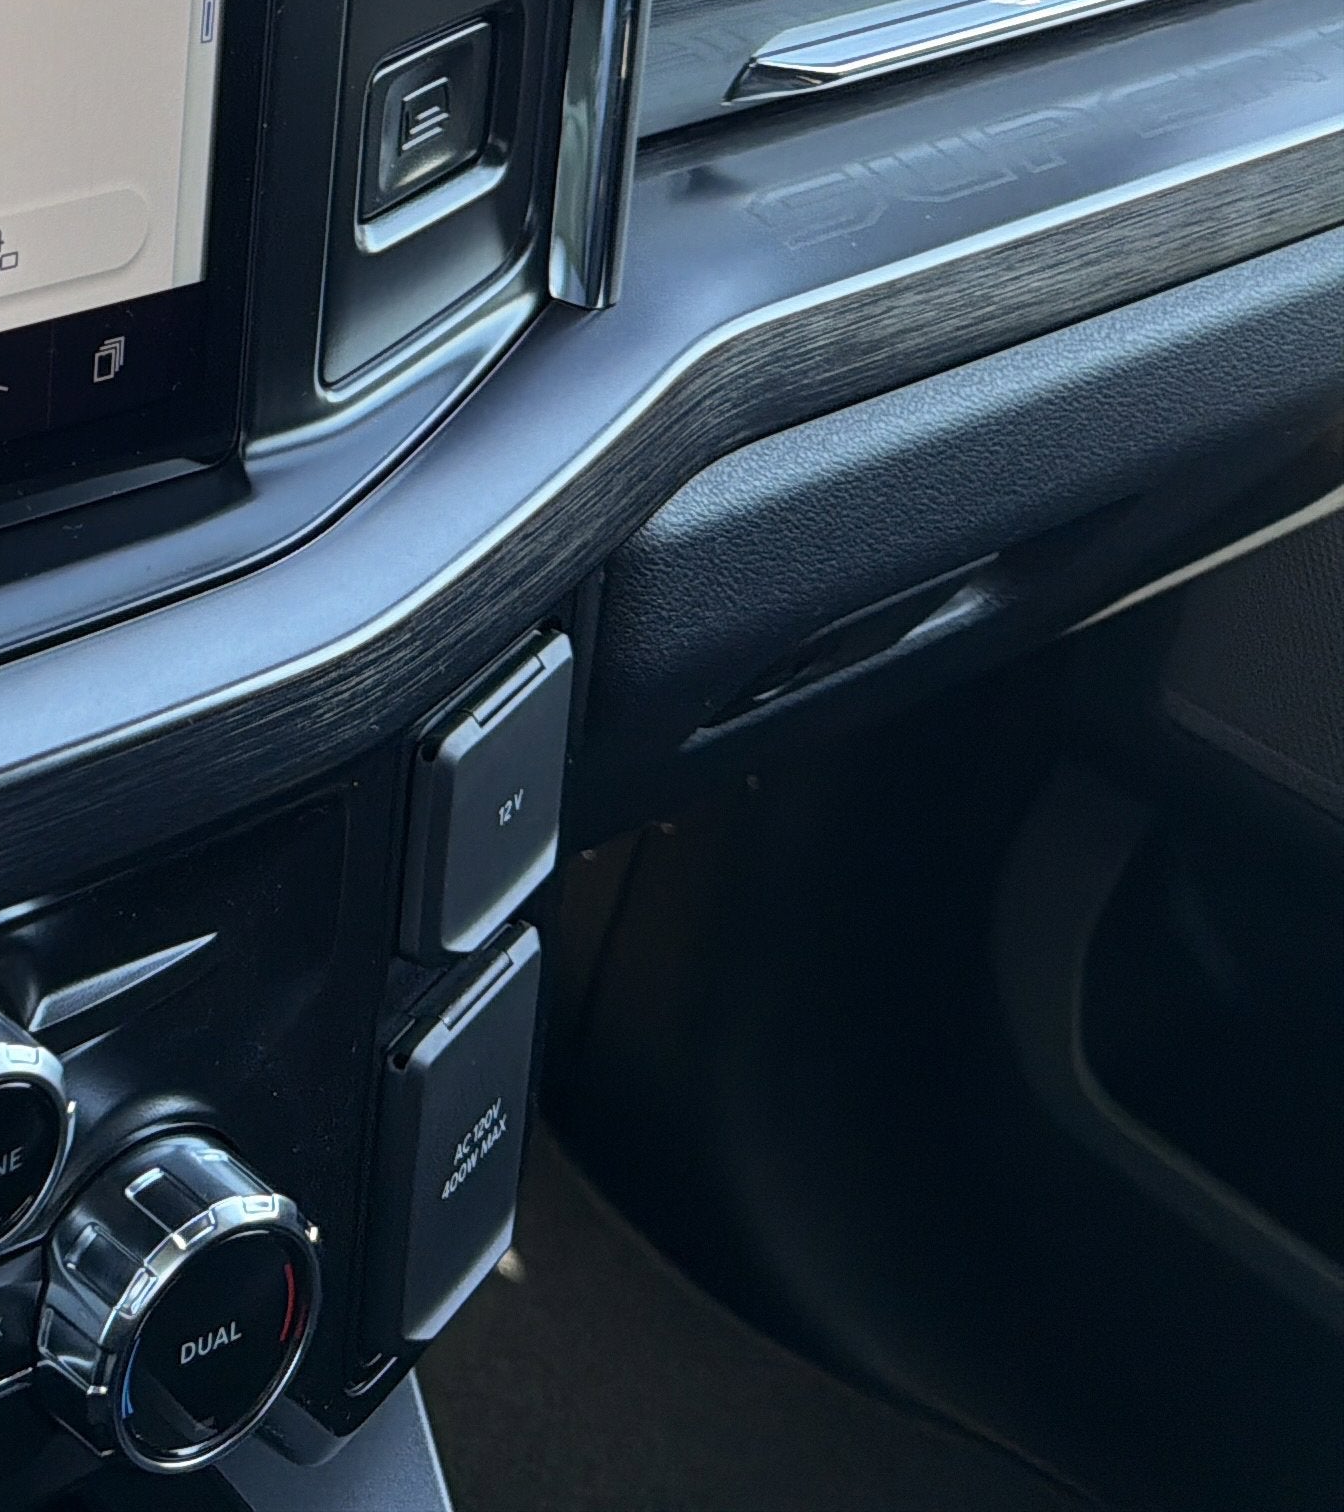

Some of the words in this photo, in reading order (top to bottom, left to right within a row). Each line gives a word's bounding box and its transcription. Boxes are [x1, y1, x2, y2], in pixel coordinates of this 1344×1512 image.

[441, 1147, 480, 1201] 400W
[480, 1112, 509, 1160] MAX
[453, 1132, 473, 1166] AC
[473, 1096, 503, 1143] 120V
[178, 1320, 243, 1366] DUAL
